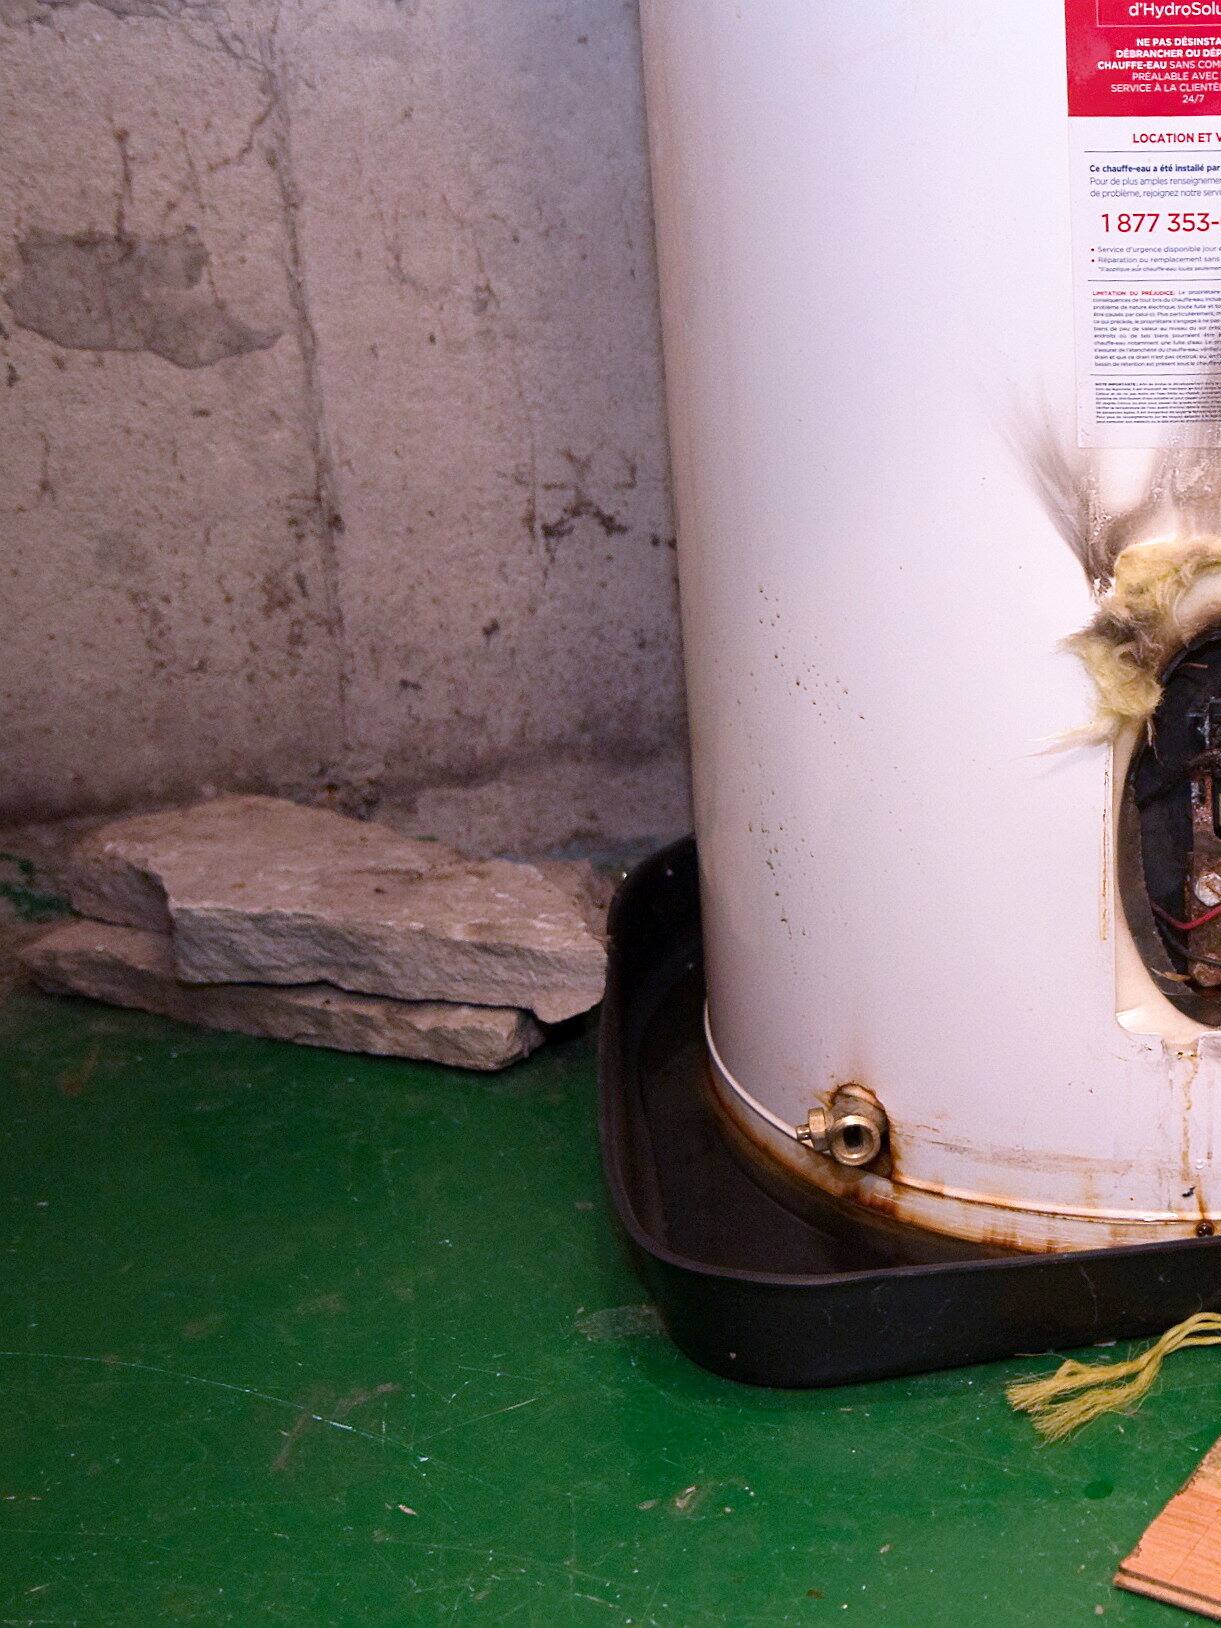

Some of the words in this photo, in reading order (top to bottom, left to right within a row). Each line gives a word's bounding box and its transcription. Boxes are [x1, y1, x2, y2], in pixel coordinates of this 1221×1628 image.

[1136, 38, 1149, 46] NE
[1152, 37, 1171, 46] PAS
[1116, 48, 1182, 57] DÉBRANCHER
[1185, 48, 1200, 57] OU
[1097, 60, 1166, 69] CHAUFFE-EAU
[1169, 60, 1195, 68] SANS
[1111, 83, 1151, 92] SERVICE
[1154, 83, 1161, 91] À
[1164, 83, 1176, 91] LA
[1182, 94, 1204, 103] 24/7
[1133, 132, 1194, 143] LOCATION
[1198, 132, 1212, 142] ET
[1102, 164, 1150, 172] chauffe-eau
[1175, 163, 1204, 171] installé
[1090, 177, 1108, 185] Pour
[1122, 177, 1138, 185] plus
[1140, 177, 1168, 185] amples
[1143, 189, 1178, 198] rejoignez
[1101, 213, 1108, 232] 1
[1117, 212, 1159, 232] 877
